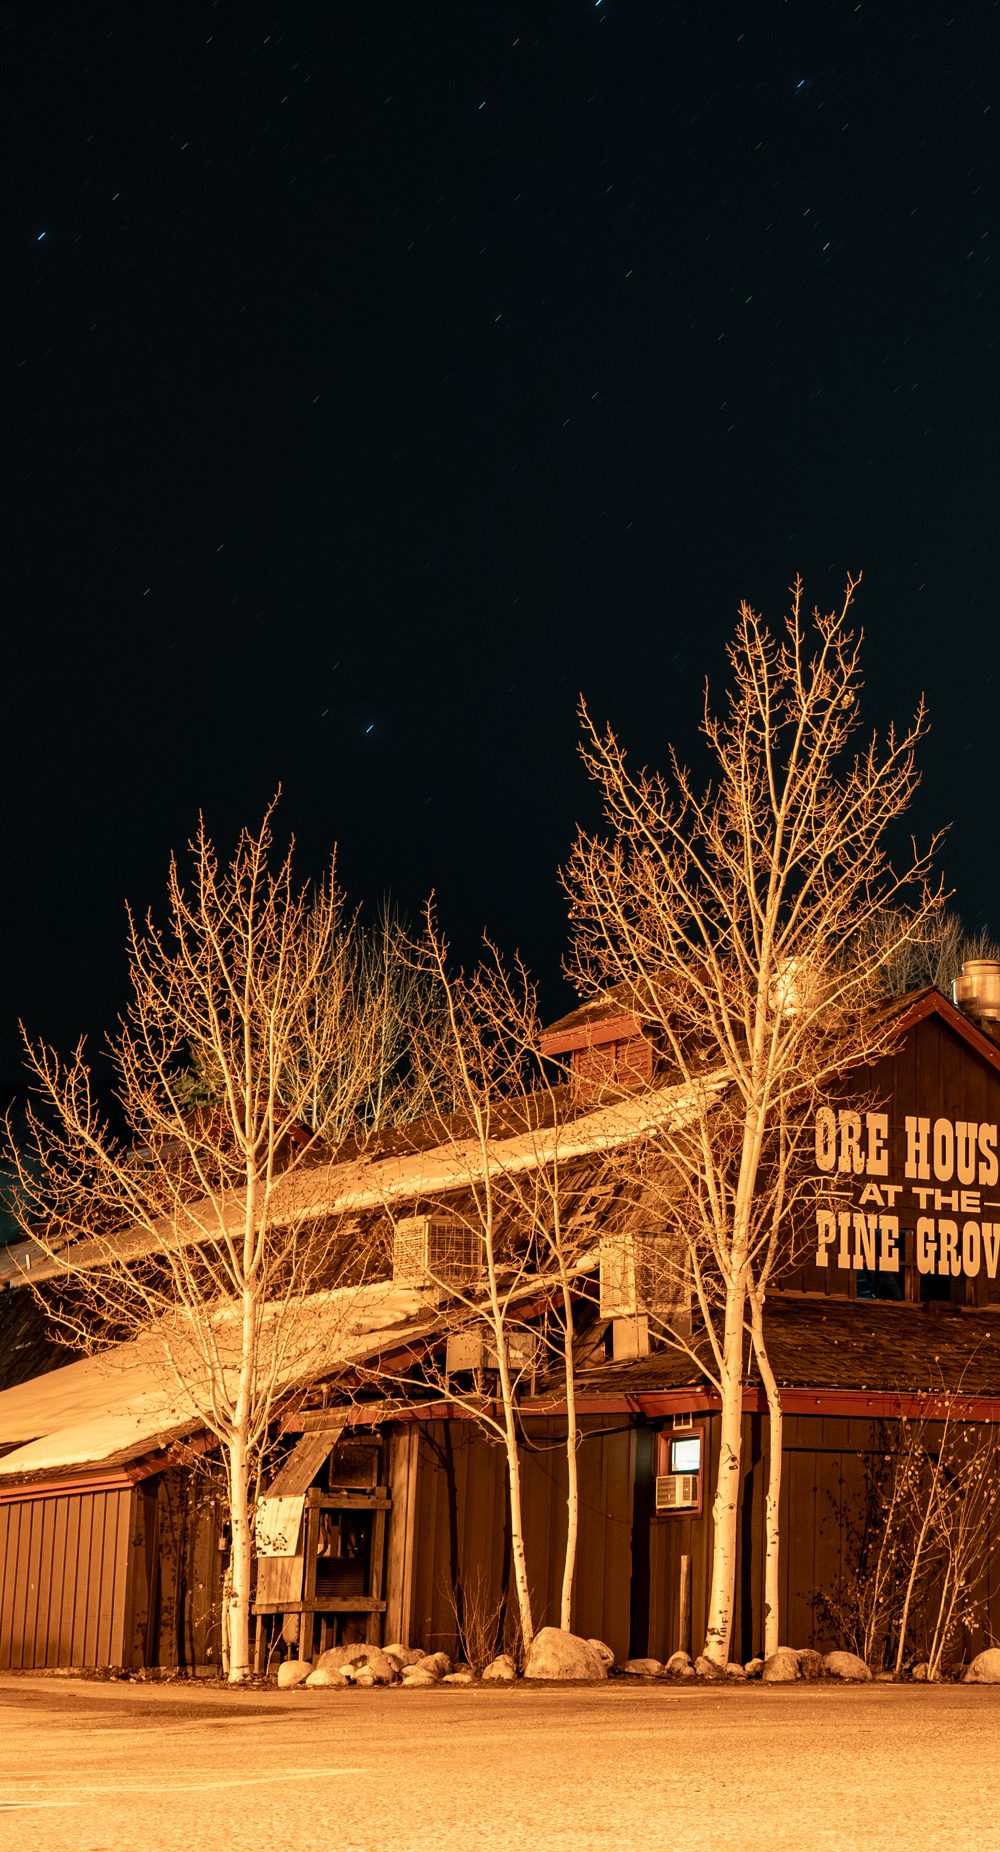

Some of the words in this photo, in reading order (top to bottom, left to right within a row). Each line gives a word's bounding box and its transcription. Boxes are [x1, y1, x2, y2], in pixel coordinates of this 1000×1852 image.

[815, 1106, 889, 1176] ORE
[858, 1183, 903, 1207] AT
[911, 1186, 981, 1213] THE
[815, 1209, 900, 1273] PINE
